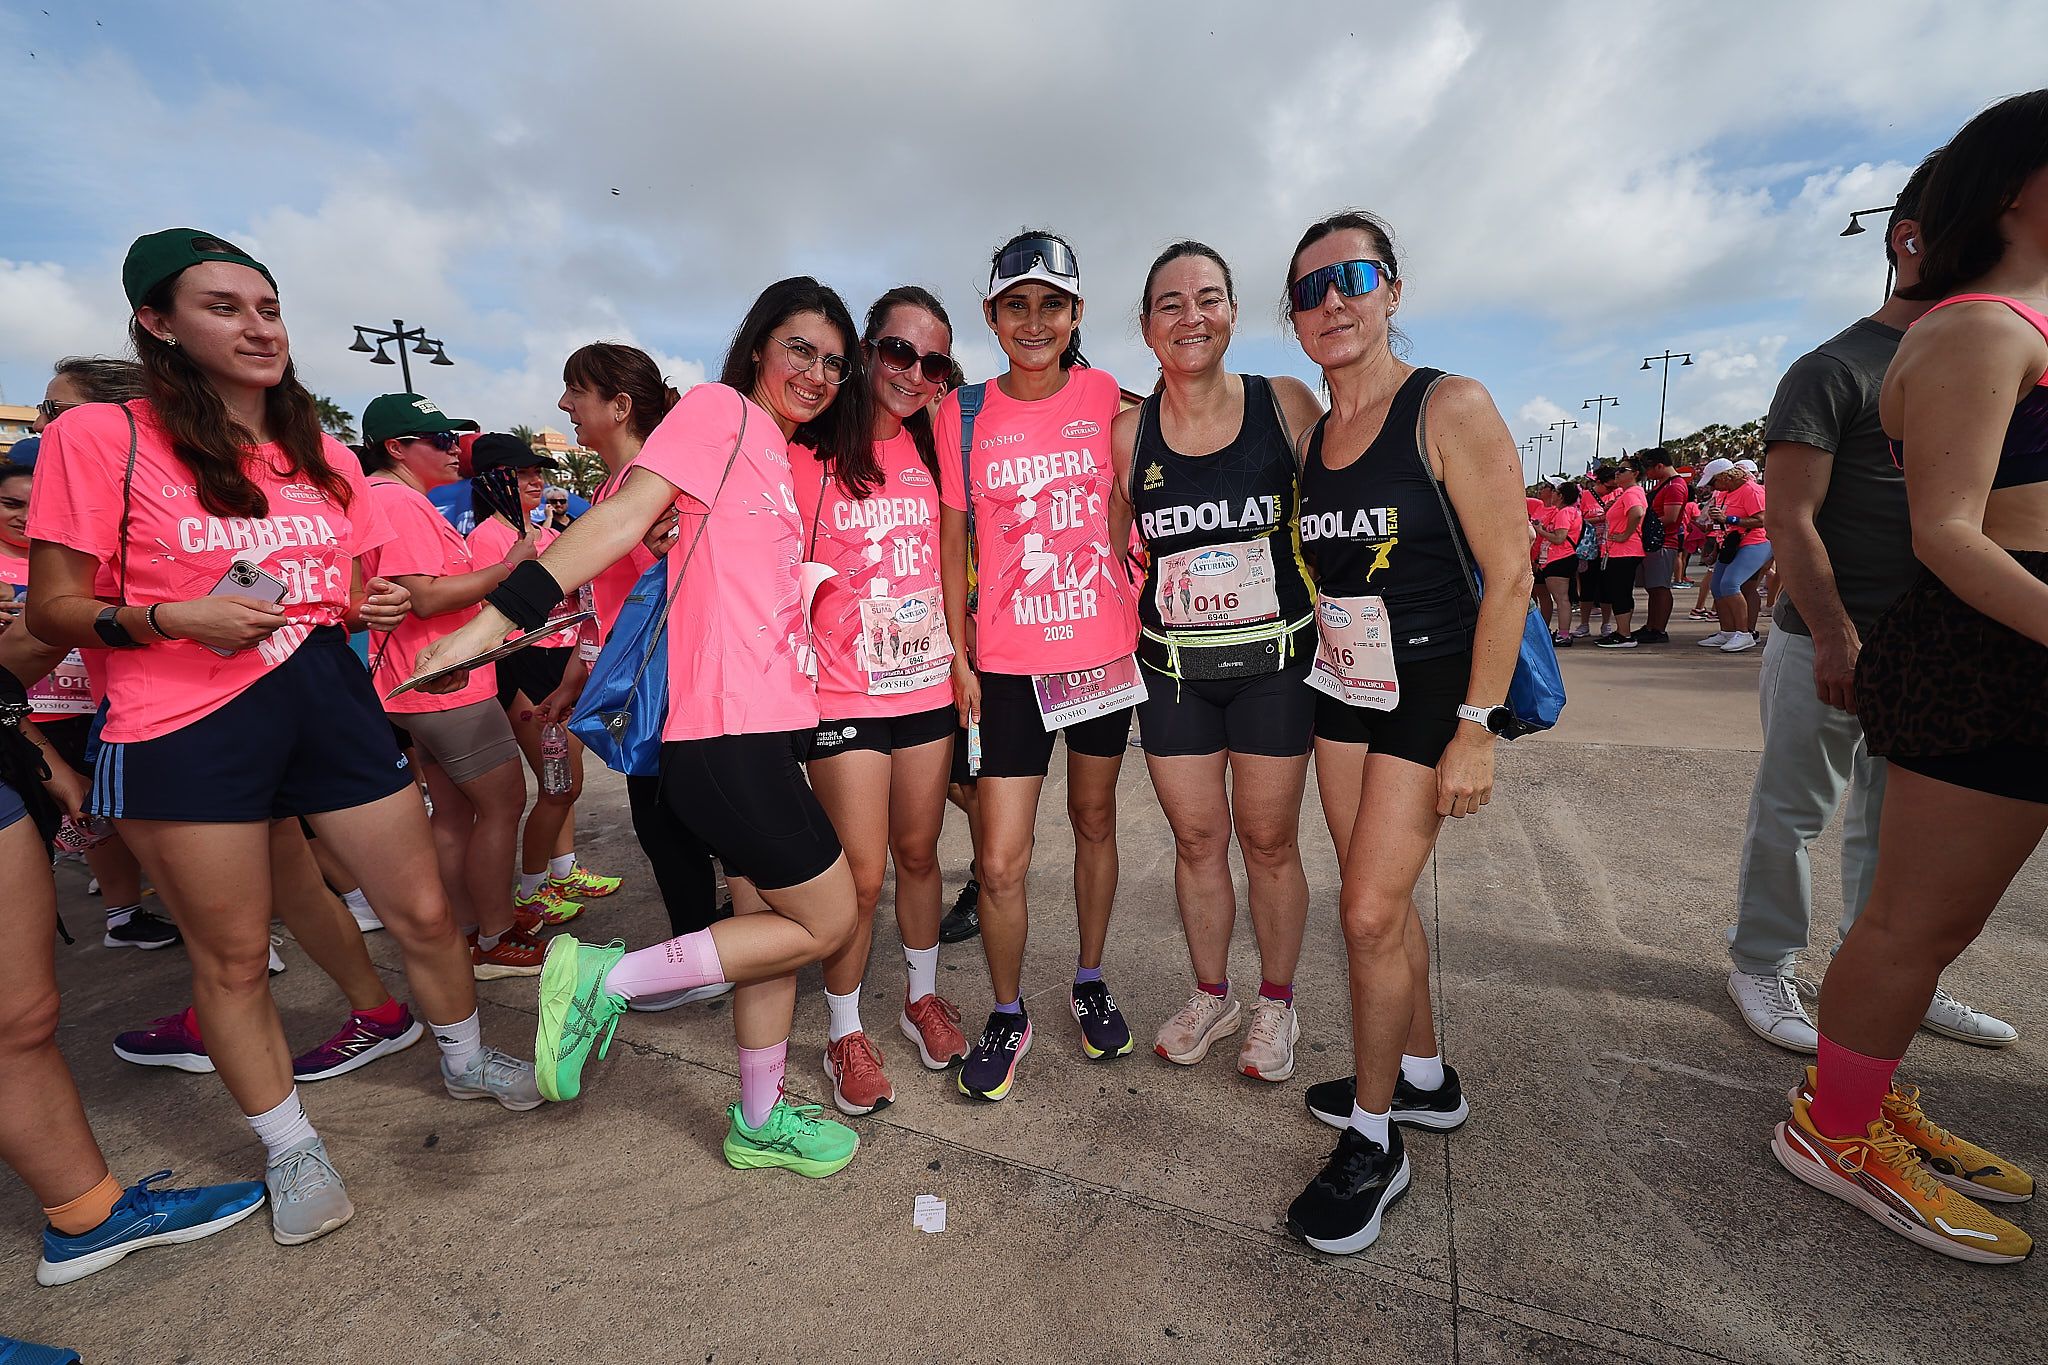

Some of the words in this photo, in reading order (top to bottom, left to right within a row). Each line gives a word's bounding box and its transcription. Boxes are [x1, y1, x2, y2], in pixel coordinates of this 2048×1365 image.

[980, 432, 1025, 450] OYSHO
[765, 448, 790, 471] OYSH
[162, 484, 197, 498] OYS
[1049, 487, 1084, 531] DE
[1141, 495, 1274, 540] REDOLAT
[1273, 495, 1281, 523] TEAM
[1300, 507, 1388, 542] EDOLAT
[1386, 507, 1398, 536] TEAM
[892, 536, 921, 577] DE
[1192, 560, 1235, 572] ASTURIANA
[1014, 588, 1098, 625] MUJER
[1194, 592, 1239, 612] 016
[1207, 613, 1229, 621] 6940
[1044, 625, 1074, 642] 2026
[902, 636, 930, 656] 016
[909, 655, 924, 665] 6942
[880, 679, 914, 689] OYSHO
[1317, 675, 1341, 693] OYSHO
[1357, 680, 1386, 690] VALENCIA
[1050, 700, 1074, 711] CARRERA
[1105, 693, 1136, 708] Santander
[1352, 693, 1387, 704] Santander
[1055, 707, 1087, 722] OYSHO
[63, 824, 87, 844] ZERO
